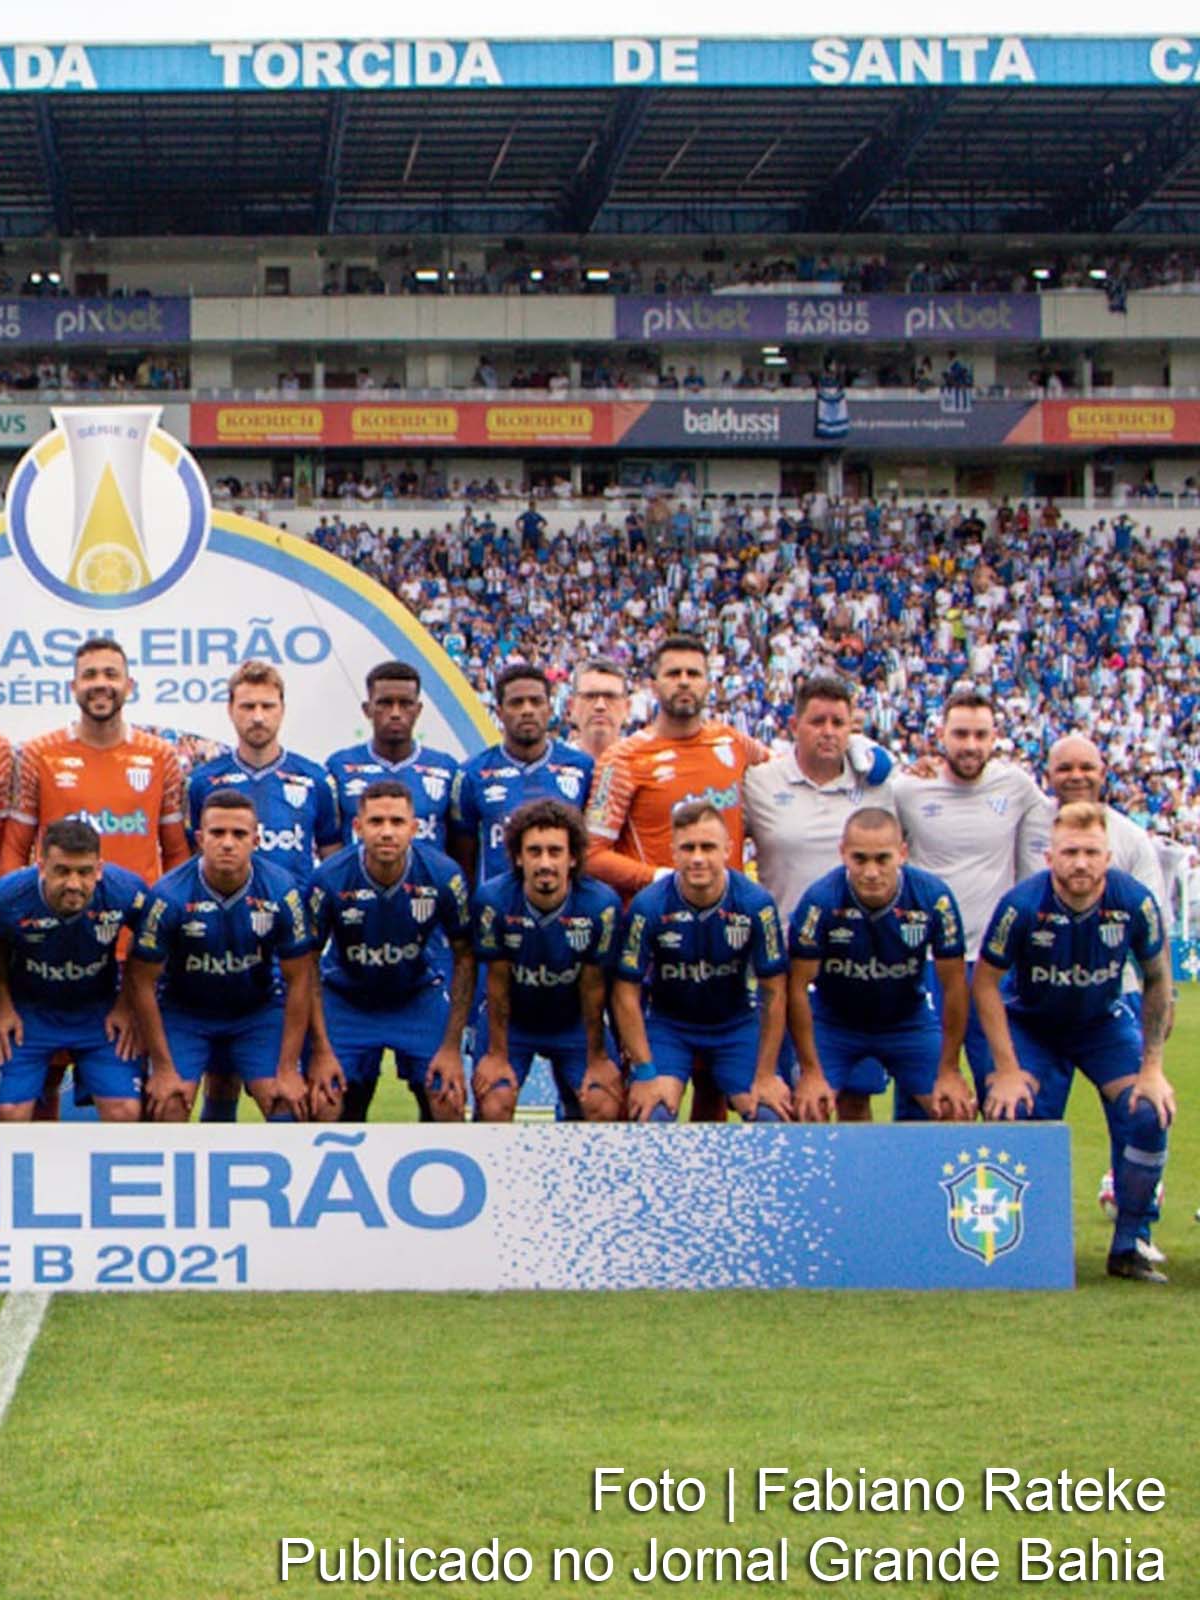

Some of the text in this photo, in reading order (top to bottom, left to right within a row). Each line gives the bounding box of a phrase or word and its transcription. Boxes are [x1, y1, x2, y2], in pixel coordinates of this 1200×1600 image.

[211, 42, 502, 87] TORCIDA
[613, 40, 698, 82] DE
[809, 37, 1036, 84] SANTA
[55, 303, 163, 341] pixbet
[643, 300, 751, 337] pixbet
[786, 302, 870, 319] SAQUE
[905, 299, 1013, 336] pixbet
[684, 407, 781, 433] baldussi
[155, 676, 230, 704] 202
[34, 1244, 74, 1284] B
[97, 1243, 248, 1284] 2021
